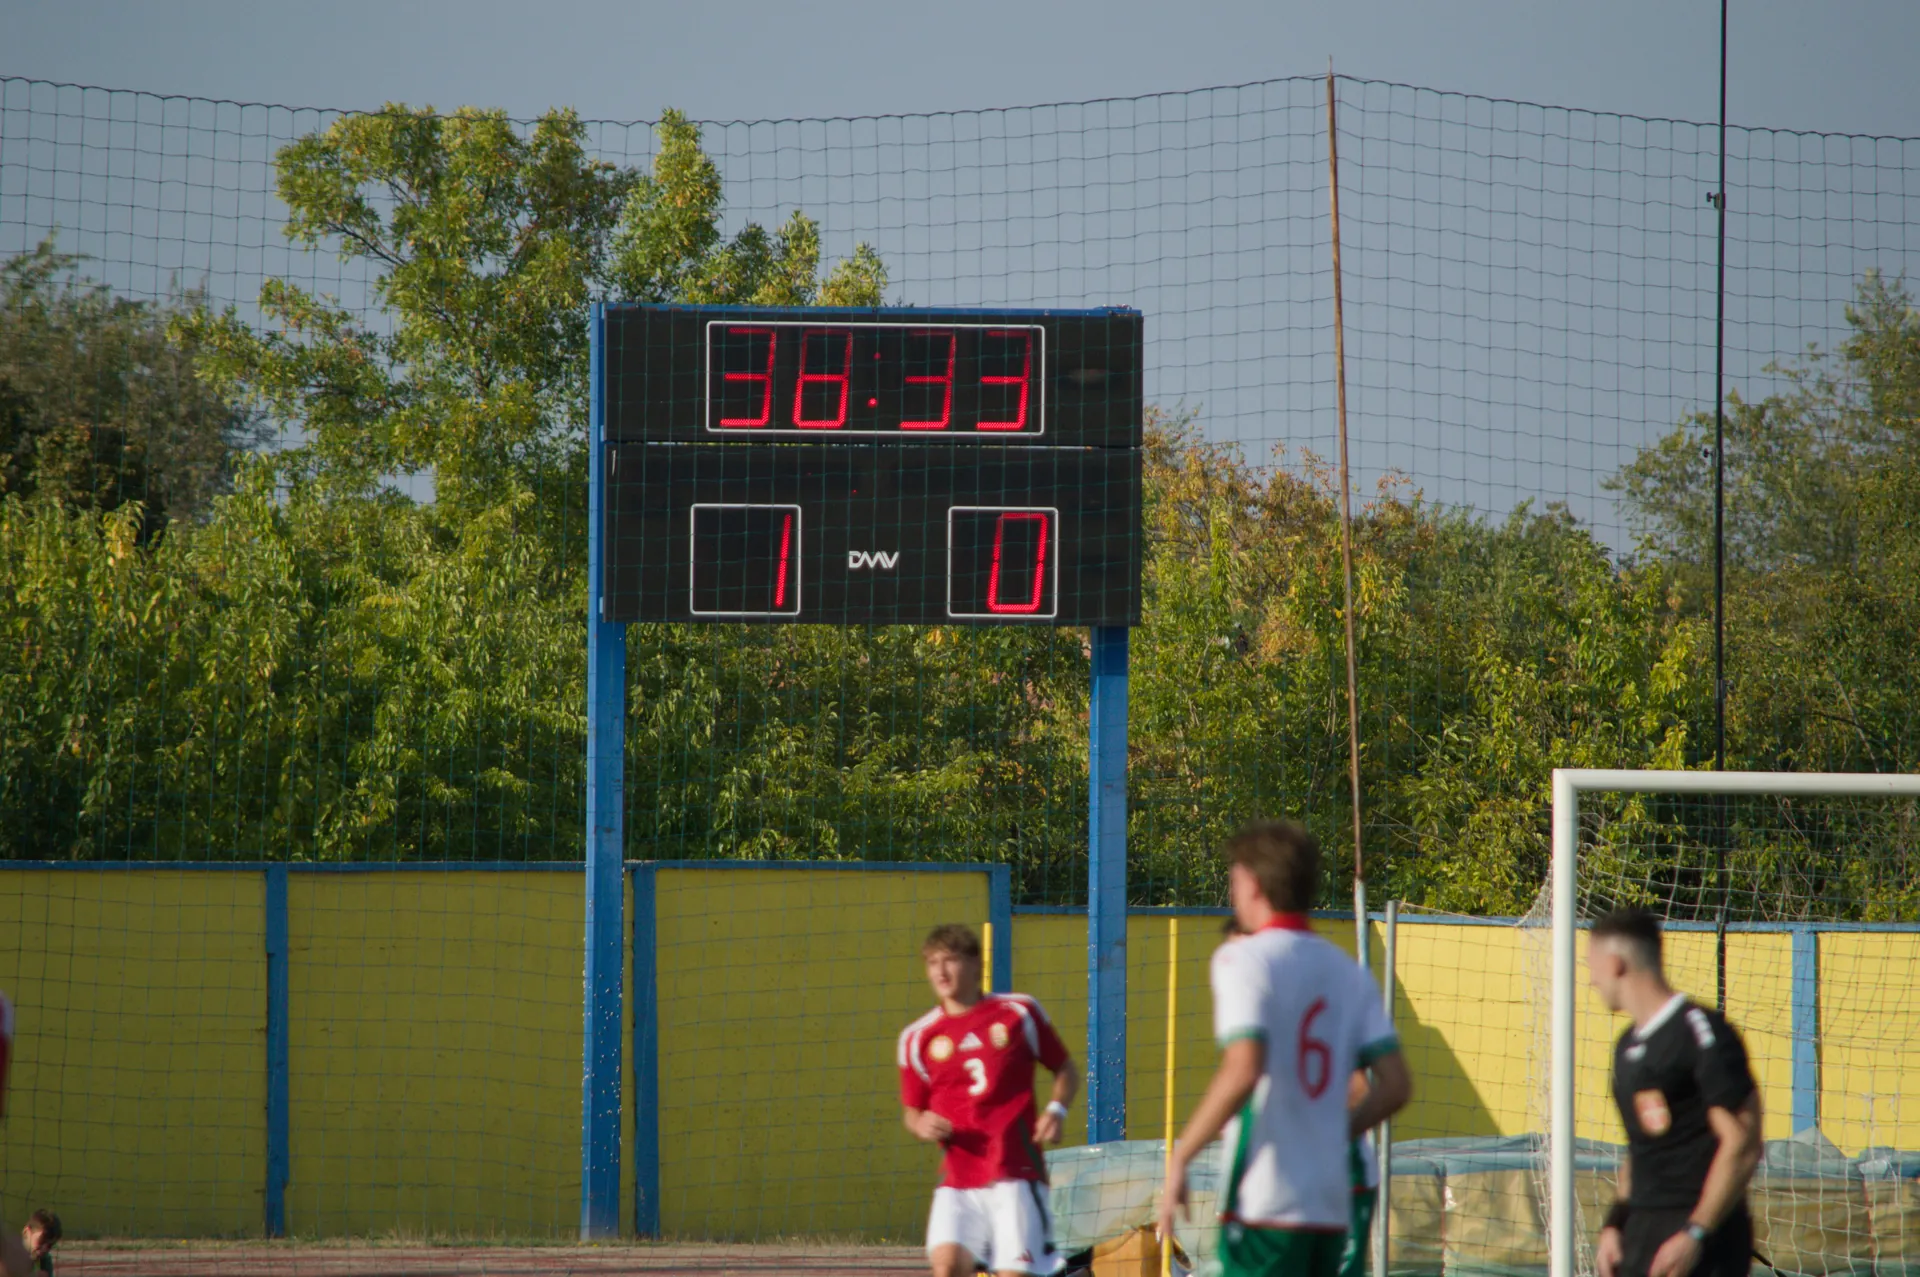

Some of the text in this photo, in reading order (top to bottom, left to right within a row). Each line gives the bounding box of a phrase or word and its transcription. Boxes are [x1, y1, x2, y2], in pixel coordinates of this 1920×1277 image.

[719, 327, 1031, 430] 38:33
[774, 513, 792, 608] 1
[848, 550, 899, 569] DMV
[987, 512, 1048, 613] 0
[963, 1058, 988, 1097] 3
[1297, 995, 1332, 1101] 6
